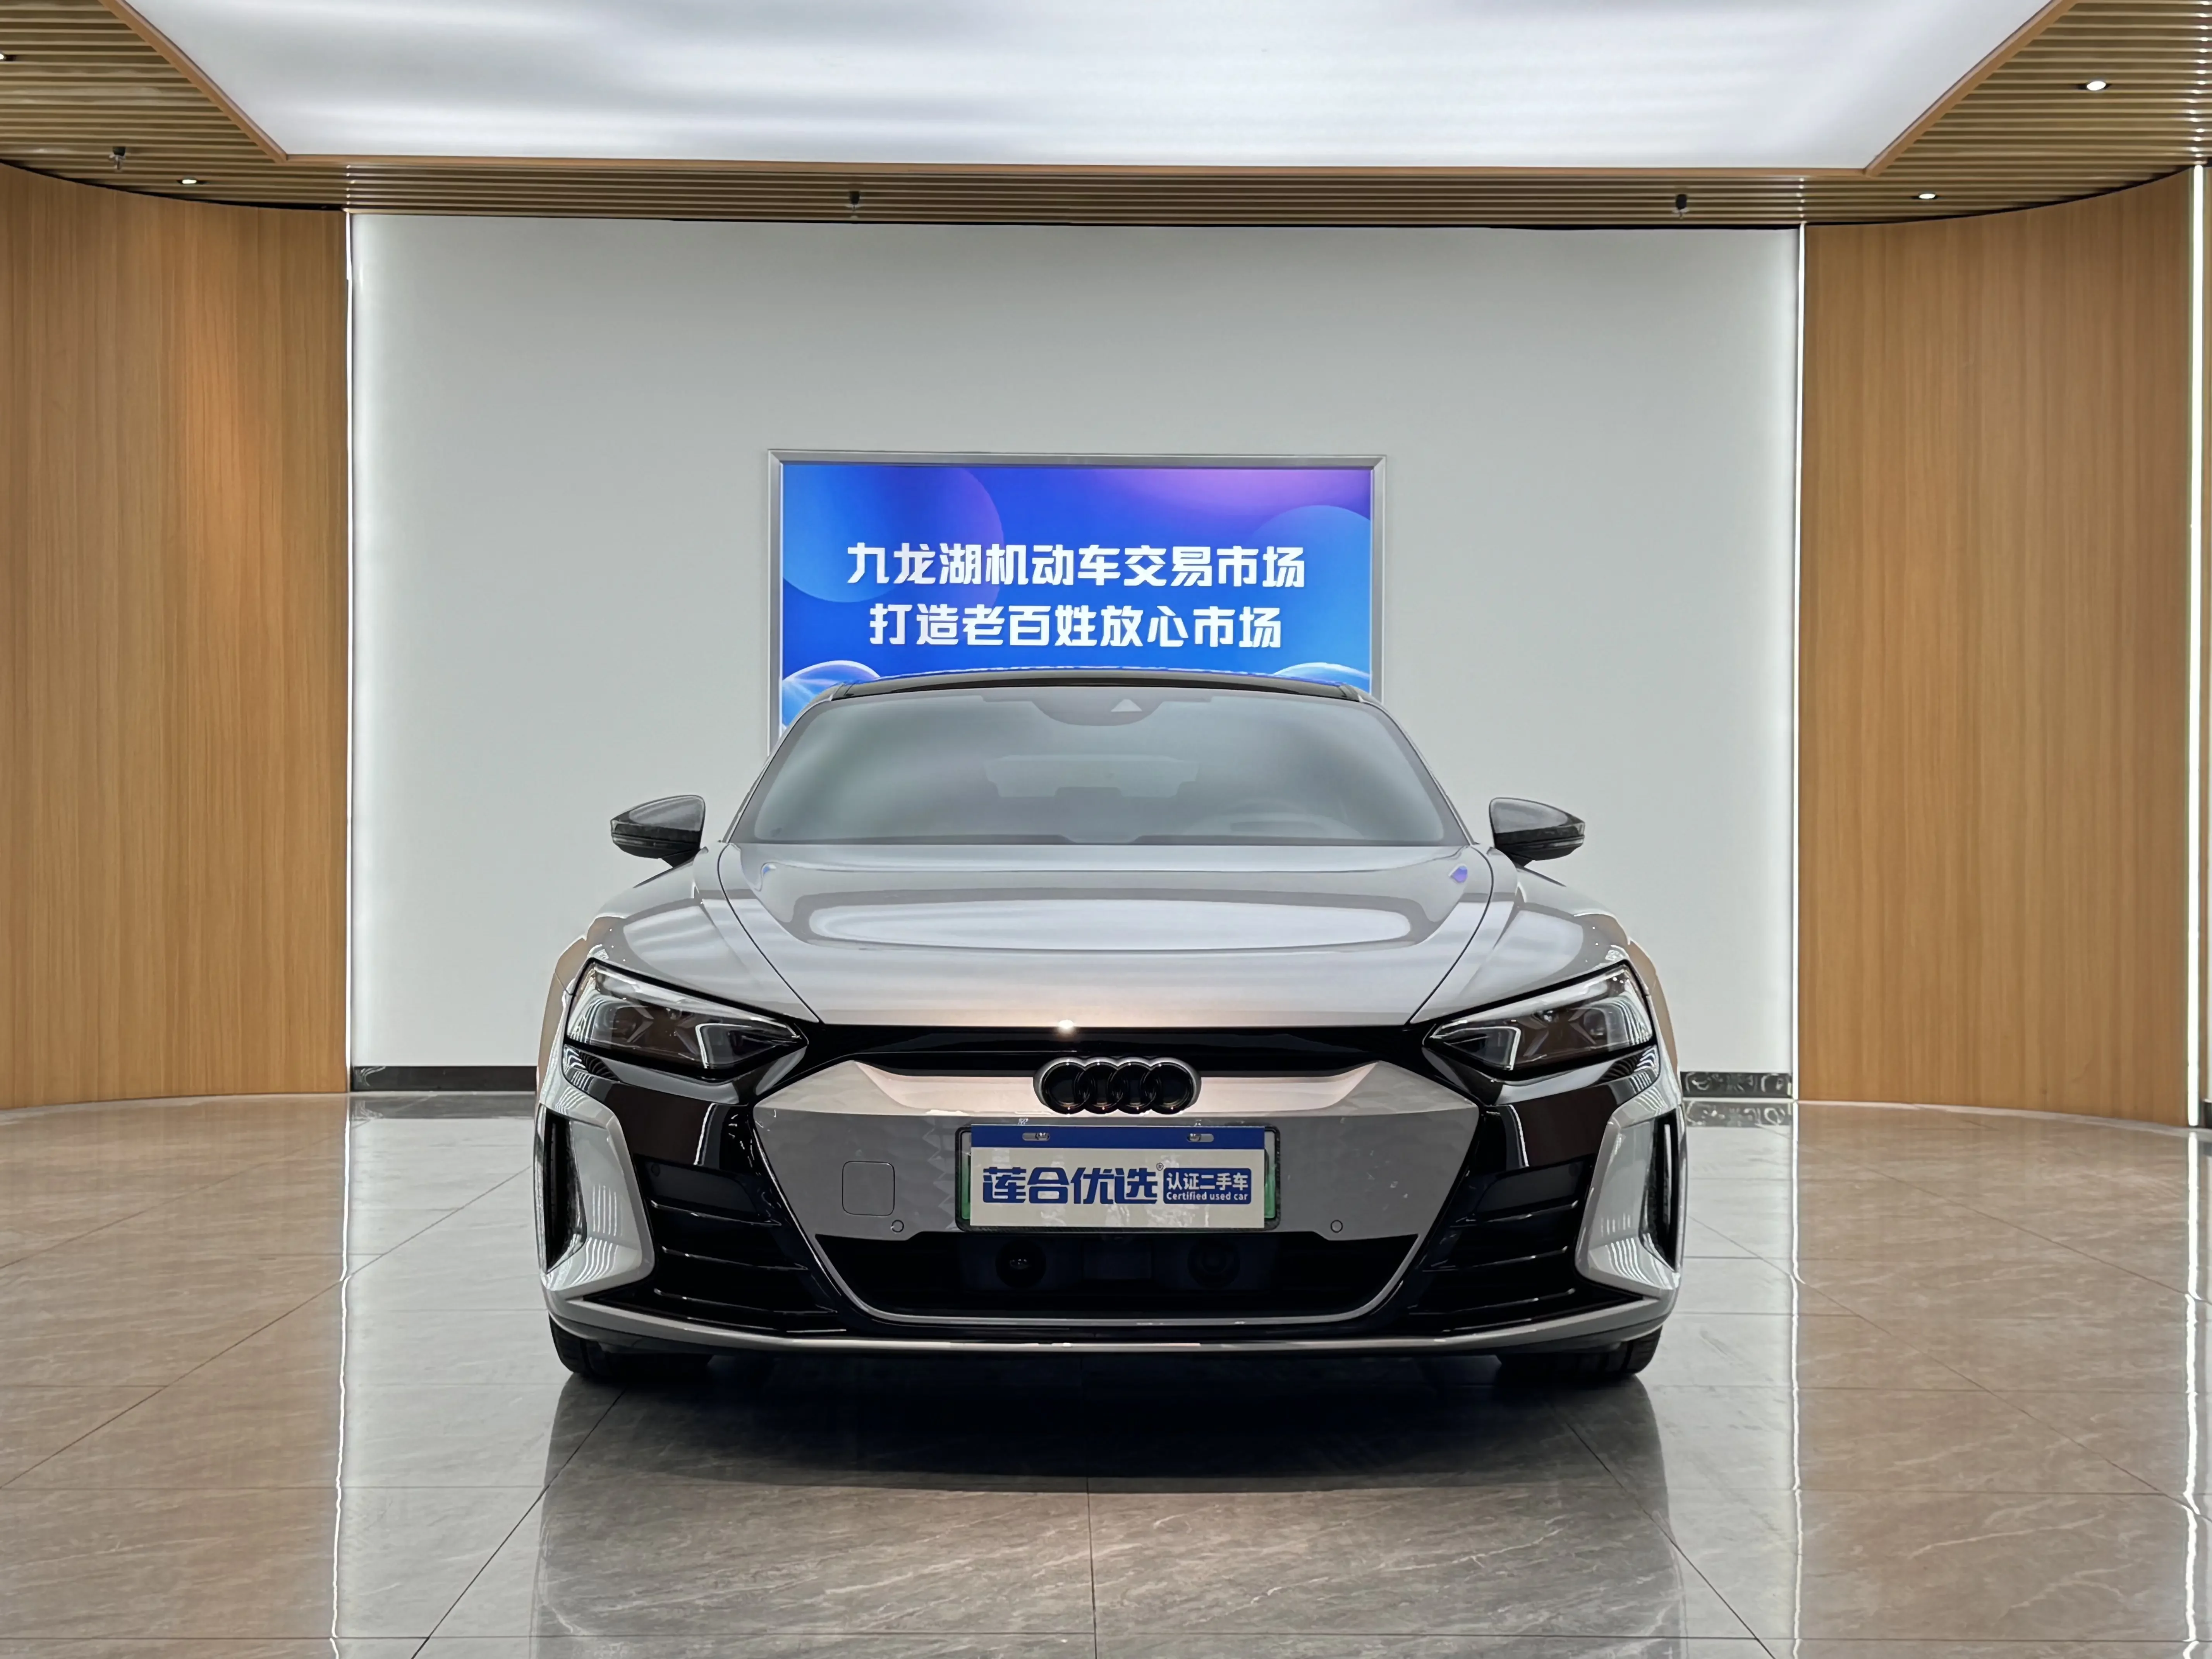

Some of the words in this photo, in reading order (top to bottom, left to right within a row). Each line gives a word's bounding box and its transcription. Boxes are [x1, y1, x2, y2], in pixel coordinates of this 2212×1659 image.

[847, 542, 1305, 588] 九龙湖机动车交易市场
[870, 603, 1281, 648] 打造老百姓放心市场
[1166, 1171, 1249, 1191] 认证二手车
[1166, 1191, 1207, 1200] Certified
[1209, 1191, 1231, 1200] used
